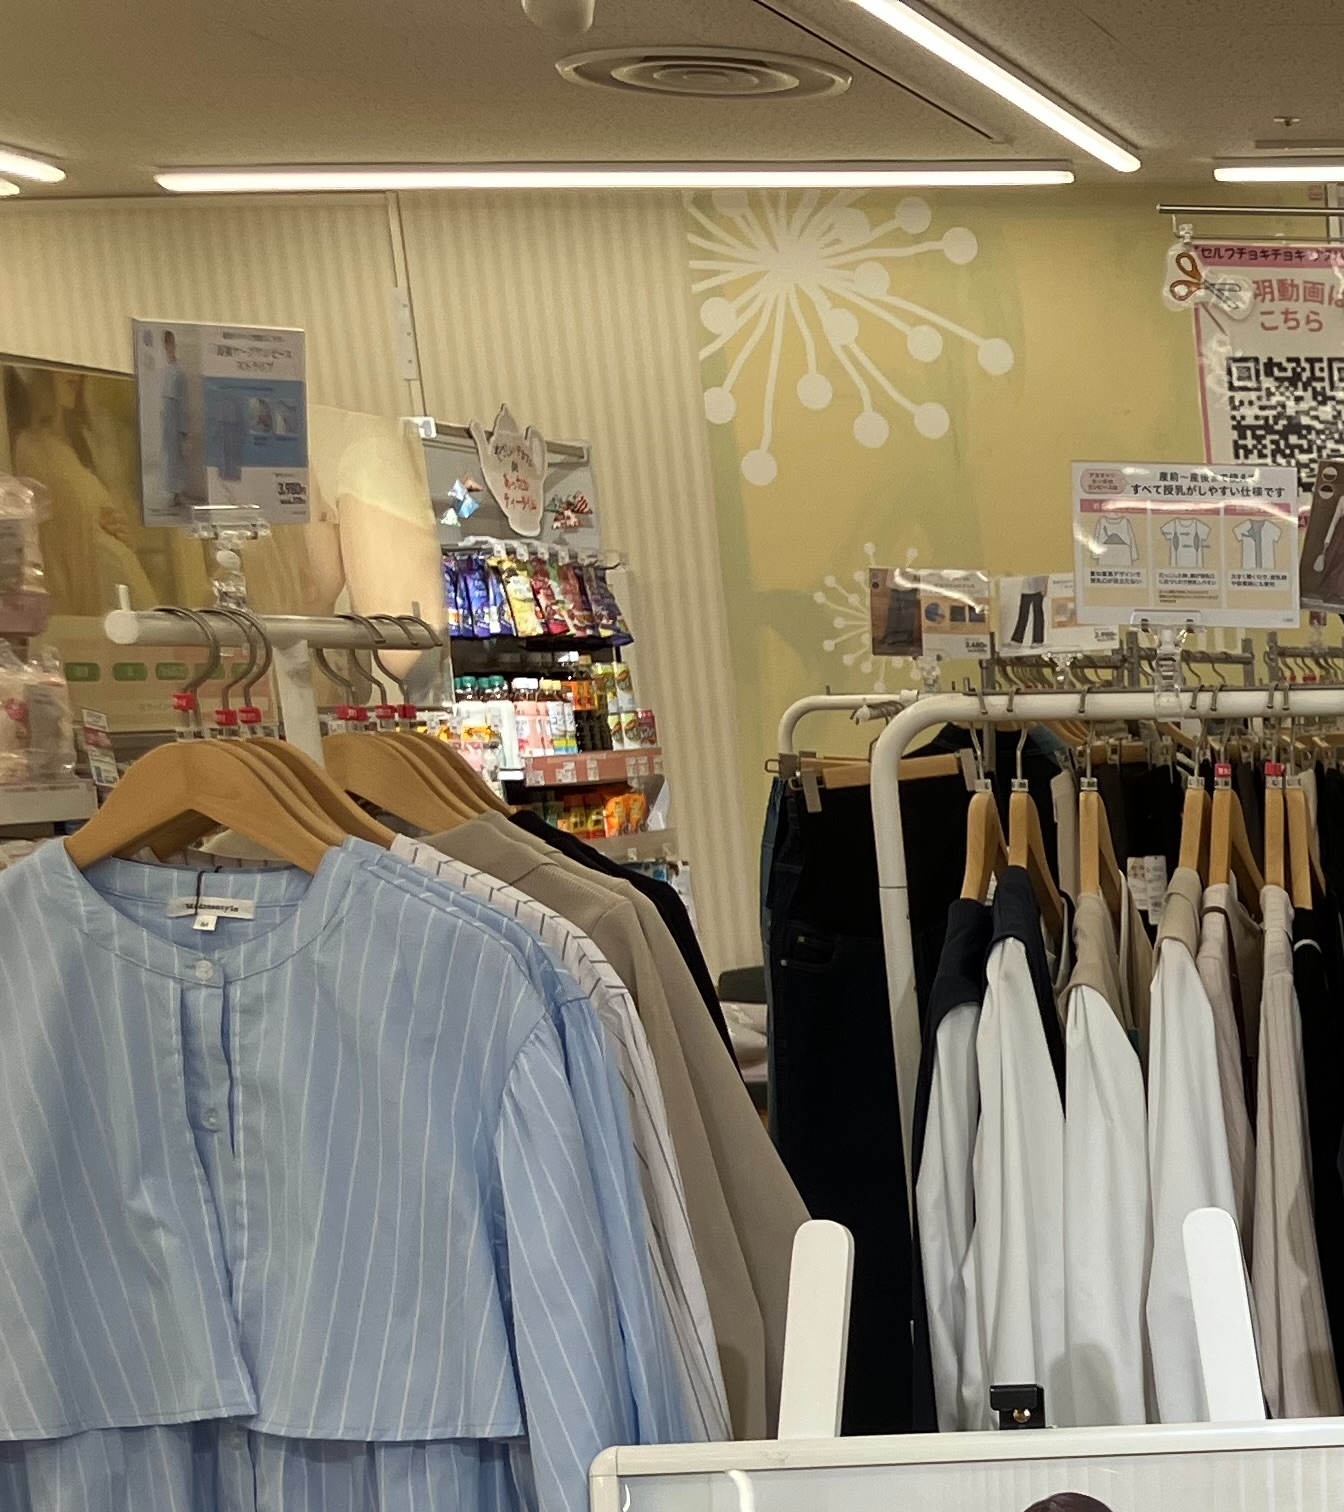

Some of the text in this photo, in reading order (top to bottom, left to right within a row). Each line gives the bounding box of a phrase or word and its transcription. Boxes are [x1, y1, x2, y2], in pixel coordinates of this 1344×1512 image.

[1259, 307, 1324, 333] こちら
[1130, 483, 1286, 498] すべて授乳がしやすい仕様です
